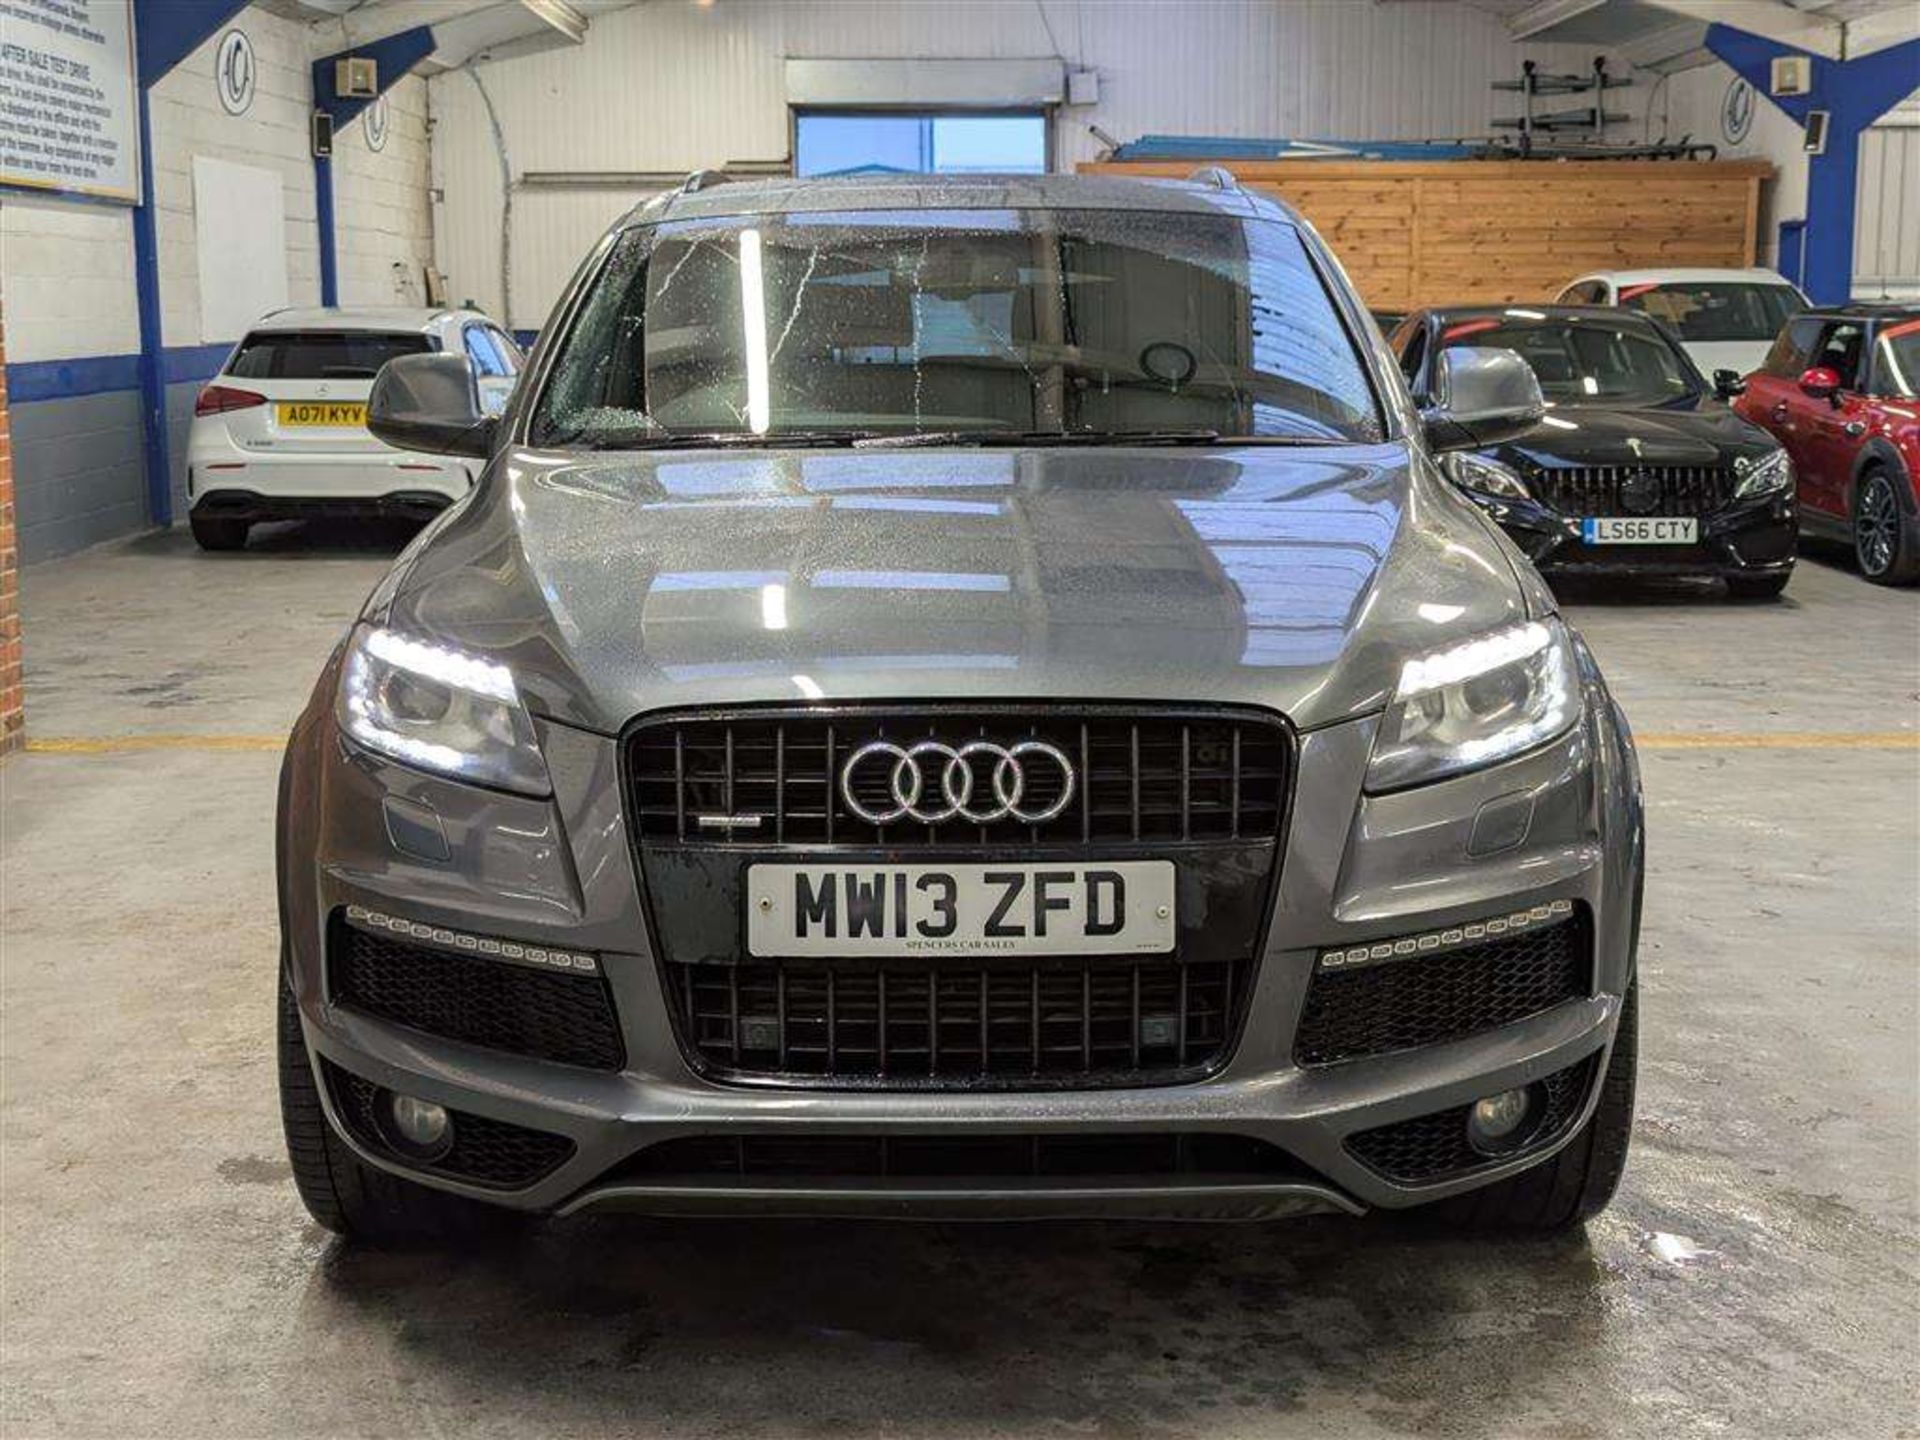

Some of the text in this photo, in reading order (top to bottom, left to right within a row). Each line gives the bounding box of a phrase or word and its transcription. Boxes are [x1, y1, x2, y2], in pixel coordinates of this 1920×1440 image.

[2, 44, 26, 64] AFTER
[29, 49, 49, 71] SALE
[50, 55, 68, 75] TEST
[69, 60, 90, 82] DRIVE
[329, 406, 362, 422] KYV
[1598, 521, 1693, 540] LS66 CTY
[795, 870, 1126, 939] MW13 ZFD
[960, 940, 982, 949] CAR
